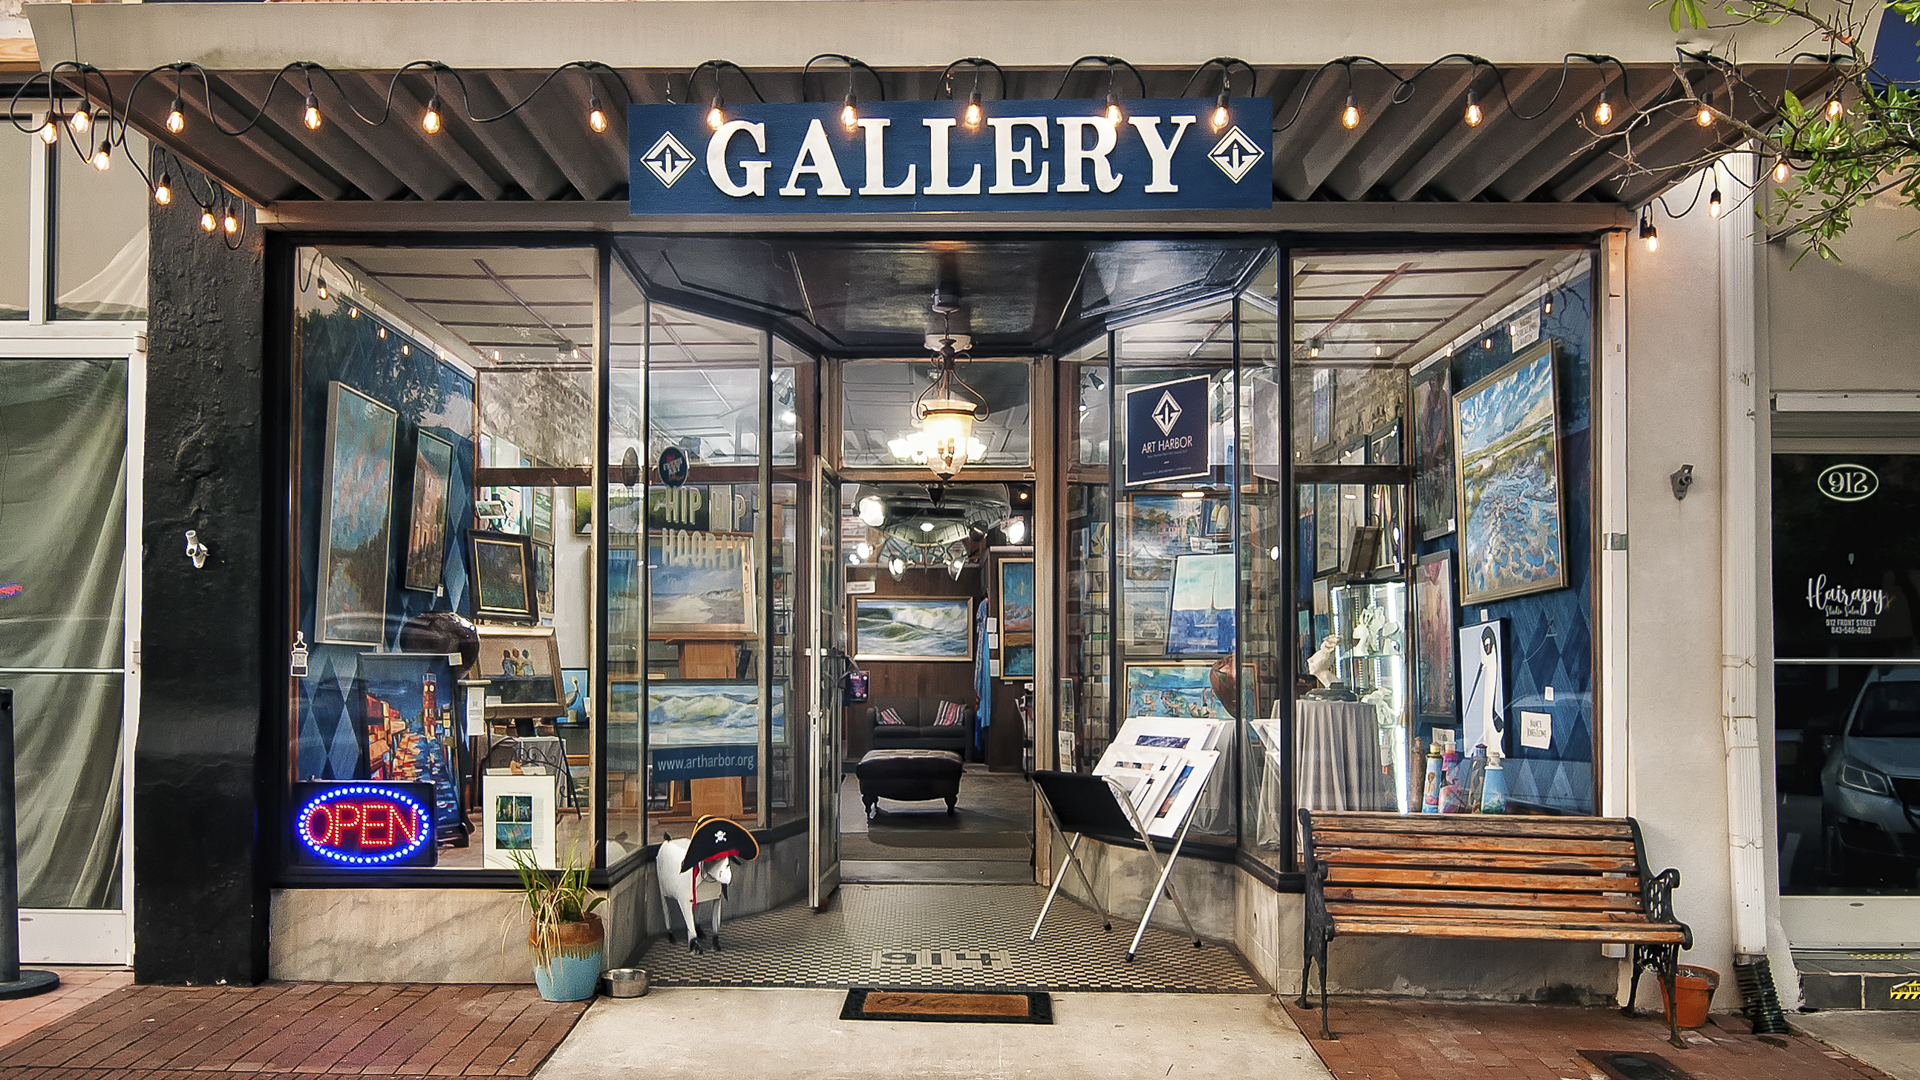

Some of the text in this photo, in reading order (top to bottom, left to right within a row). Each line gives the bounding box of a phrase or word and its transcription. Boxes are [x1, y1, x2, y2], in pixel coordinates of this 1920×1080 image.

[706, 115, 1197, 197] GALLERY
[1141, 441, 1156, 454] ART
[1158, 435, 1193, 452] HARBOR
[1828, 471, 1868, 493] 912
[665, 487, 702, 525] HIP
[661, 527, 746, 570] HOORAY
[1805, 573, 1886, 616] Hairapy
[1836, 619, 1855, 627] FRONT
[1856, 619, 1876, 627] STREET
[657, 752, 754, 772] www.artharbor.org
[304, 803, 419, 846] OPEN
[881, 952, 1001, 966] 914
